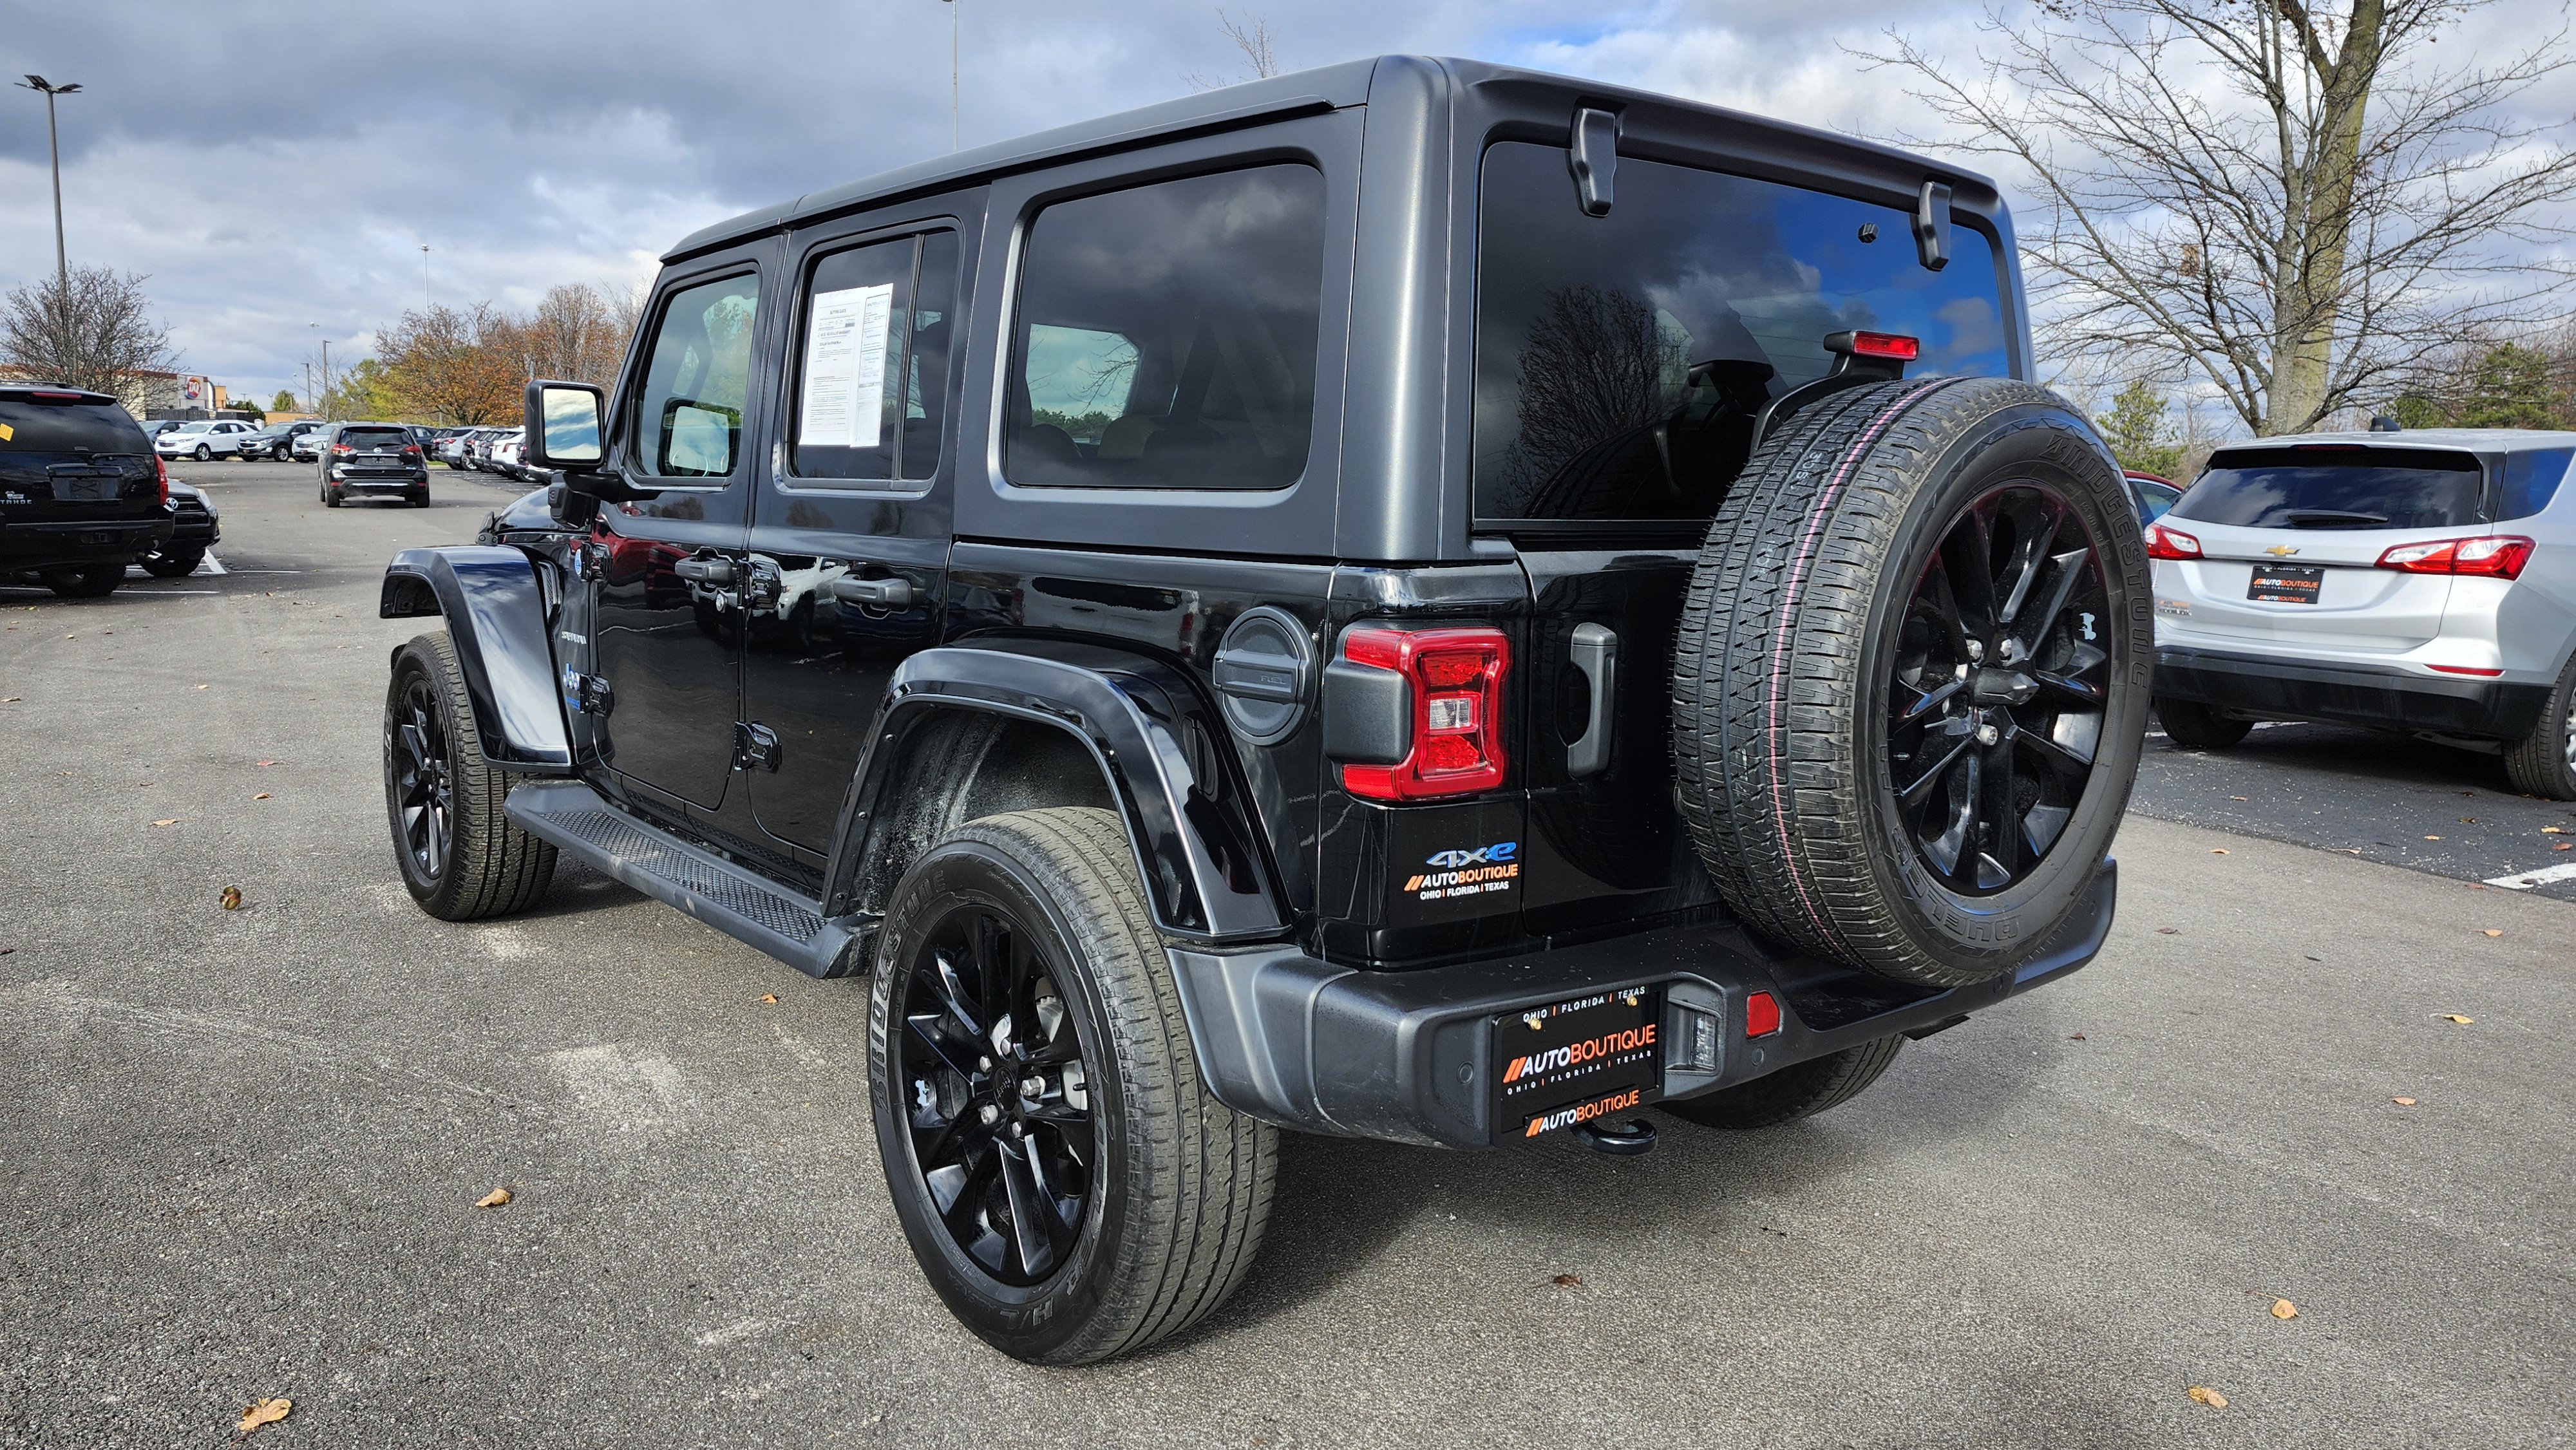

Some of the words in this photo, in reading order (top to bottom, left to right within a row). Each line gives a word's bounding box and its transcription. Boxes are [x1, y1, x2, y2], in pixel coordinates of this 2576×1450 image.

[2040, 433, 2148, 688] BRIDGESTONE
[2260, 578, 2318, 588] AUTOBOUTIQUE
[1260, 675, 1287, 685] FUEL
[1419, 890, 1442, 901] OHIO
[1446, 885, 1481, 897] FLORIDA
[1484, 880, 1510, 892] TEXAS
[1420, 863, 1519, 889] AUTOBOUTIQUE
[870, 871, 947, 1115] BRIDGESTONE
[1522, 1008, 1548, 1023] OHIO
[1561, 995, 1605, 1013] FLORIDA
[1617, 986, 1645, 1000] TEXAS
[1520, 1023, 1656, 1078] AUTOBOUTIQUE
[1507, 1081, 1537, 1096] OHIO
[1550, 1063, 1602, 1083] FLORIDA
[1616, 1050, 1652, 1065] TEXAS
[1539, 1089, 1640, 1133] AUTOBOUTIQUE
